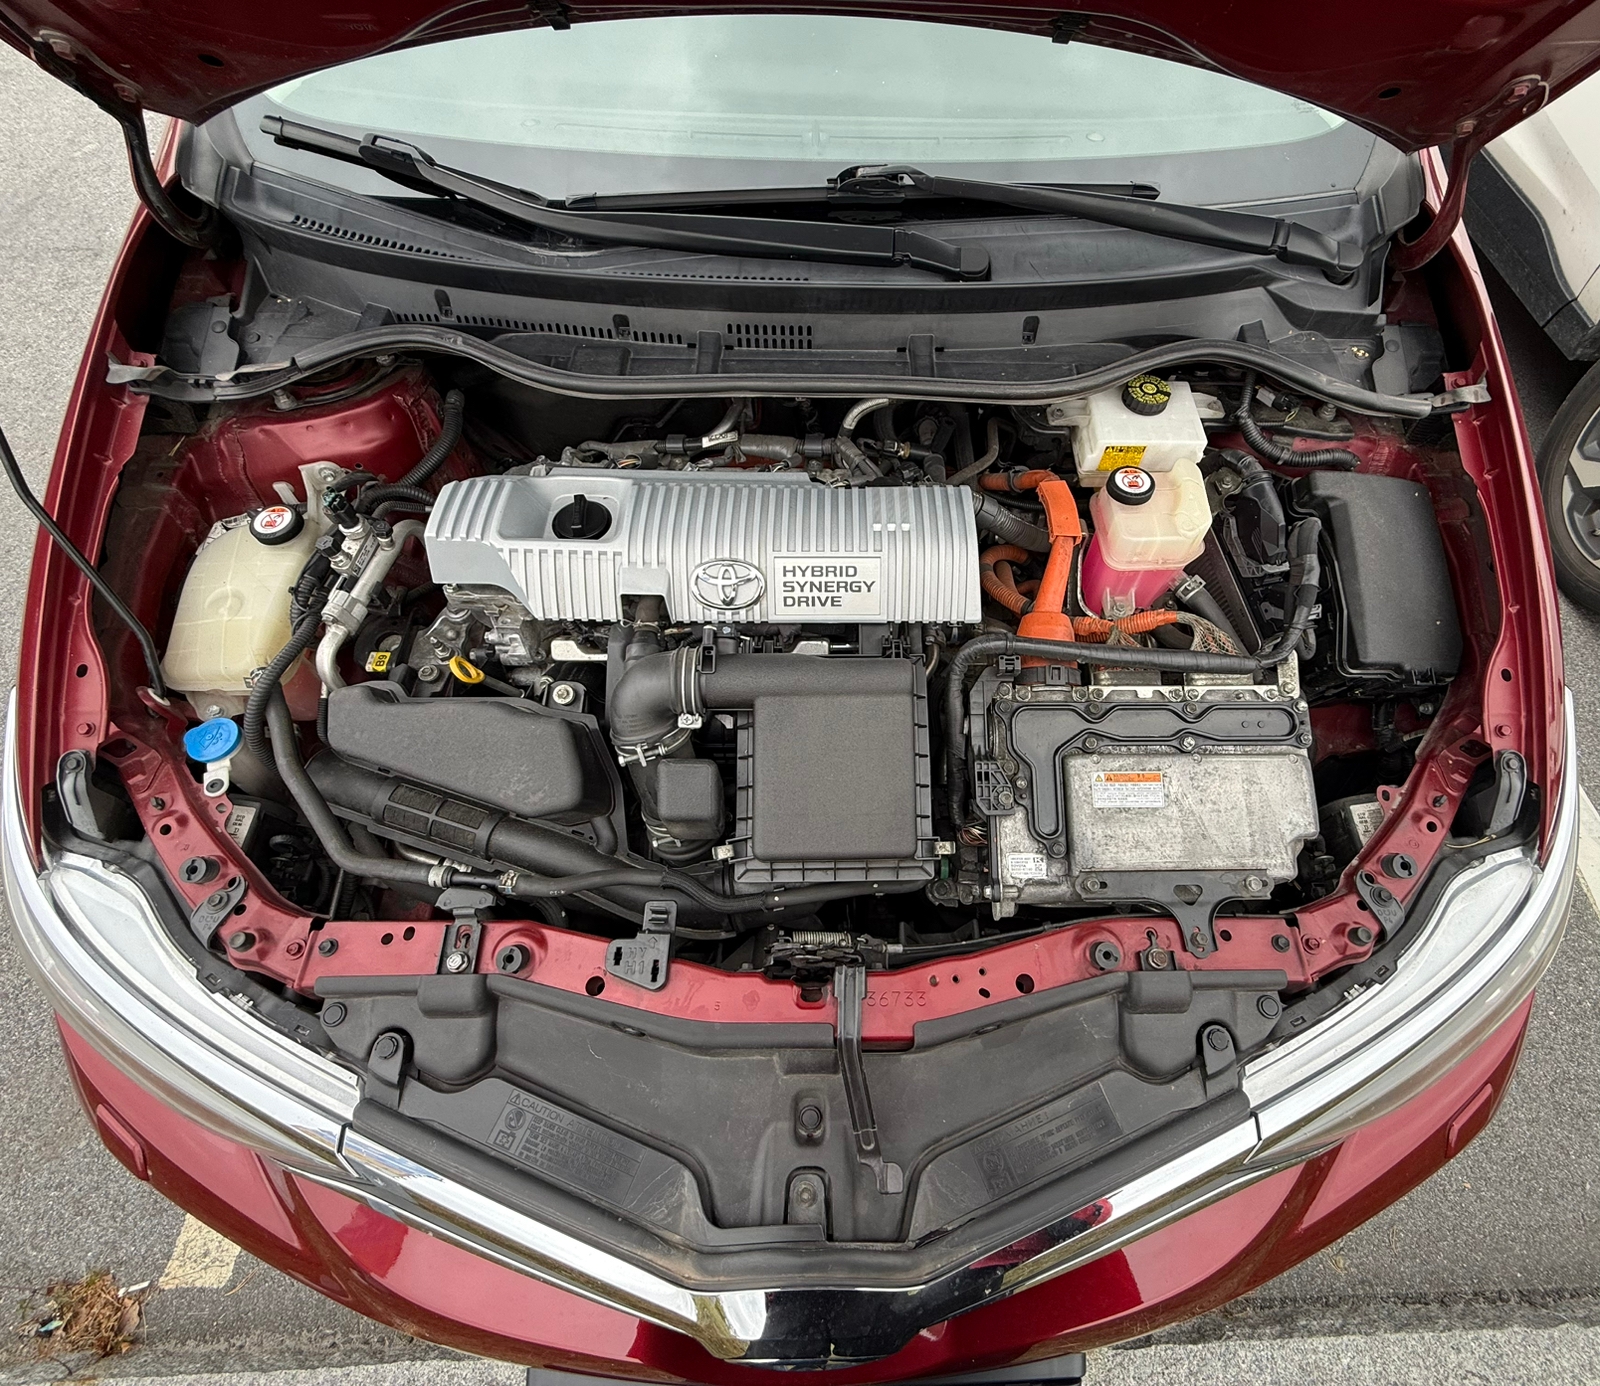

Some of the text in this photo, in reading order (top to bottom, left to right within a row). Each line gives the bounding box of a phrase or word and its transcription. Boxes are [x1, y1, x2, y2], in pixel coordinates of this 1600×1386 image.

[782, 565, 858, 578] HYBRID
[782, 580, 876, 593] SYNERGY
[782, 595, 843, 607] DRIVE
[375, 654, 388, 667] B9
[866, 990, 927, 1007] 36733
[521, 1097, 565, 1124] CAUTION
